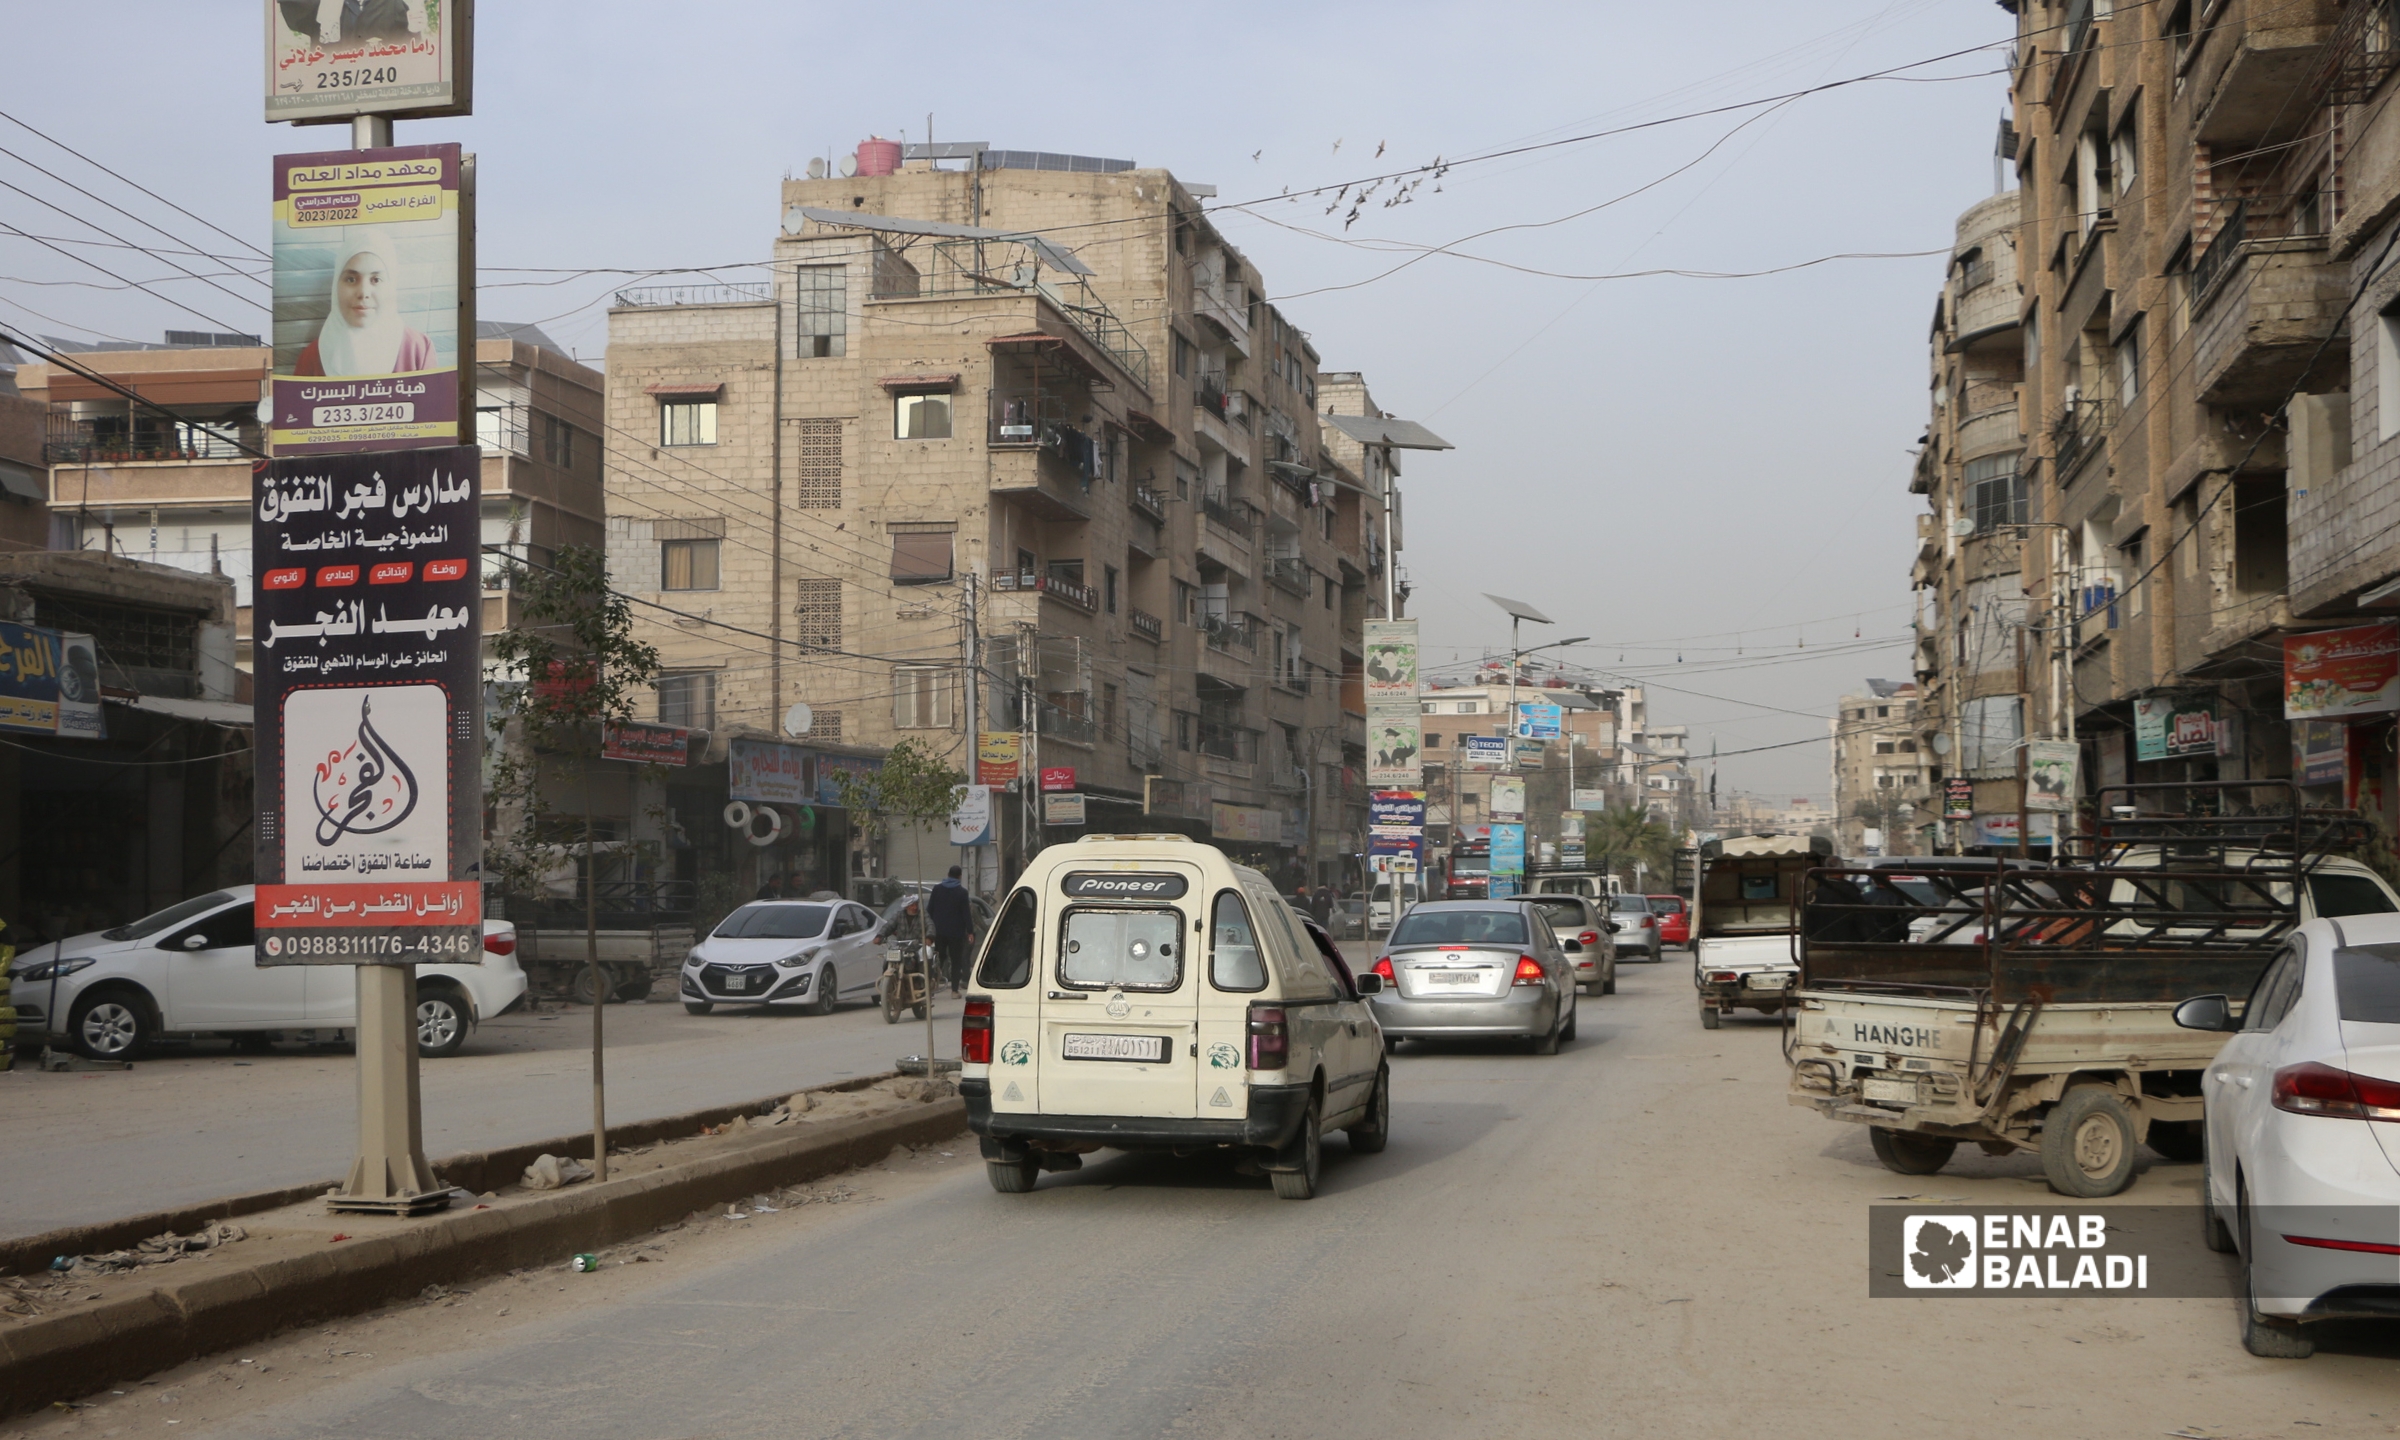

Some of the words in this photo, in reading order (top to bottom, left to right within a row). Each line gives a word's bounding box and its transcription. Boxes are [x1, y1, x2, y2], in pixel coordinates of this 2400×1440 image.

[368, 43, 406, 57] محمد
[411, 37, 435, 55] راما
[279, 45, 324, 70] خولاني
[328, 47, 364, 64] ميسر
[317, 67, 397, 88] 235/240
[386, 163, 437, 177] معهد
[297, 196, 332, 209] الدراسي
[334, 195, 359, 205] للعام
[366, 197, 406, 214] العلمي
[408, 195, 436, 207] الفرع
[297, 208, 358, 222] 2023/2022
[359, 379, 392, 399] بشار
[395, 379, 426, 396] هبة
[322, 405, 404, 423] 233.3/240
[336, 471, 386, 520] فجر
[392, 468, 471, 518] مدارس
[282, 530, 351, 551] الخاصة
[355, 524, 448, 552] النموذجية
[274, 570, 298, 584] ثانوي
[325, 570, 354, 581] إعدادي
[377, 566, 407, 579] ابتدائي
[432, 564, 458, 576] روضة
[262, 599, 366, 648] الفجر
[372, 602, 469, 641] معهد
[320, 654, 354, 674] الذهبي
[356, 652, 388, 670] الوسام
[390, 652, 412, 668] على
[415, 650, 448, 667] الحائز
[990, 738, 1008, 746] صالون
[1000, 752, 1016, 760] الربيع
[394, 853, 432, 870] صناعة
[270, 894, 320, 918] الفجر
[324, 898, 356, 918] من
[358, 894, 412, 918] القطر
[416, 889, 463, 916] أوائل
[286, 934, 470, 955] 0988311176-4346
[1854, 1023, 1941, 1048] HANGHE
[1068, 1046, 1099, 1055] 851211
